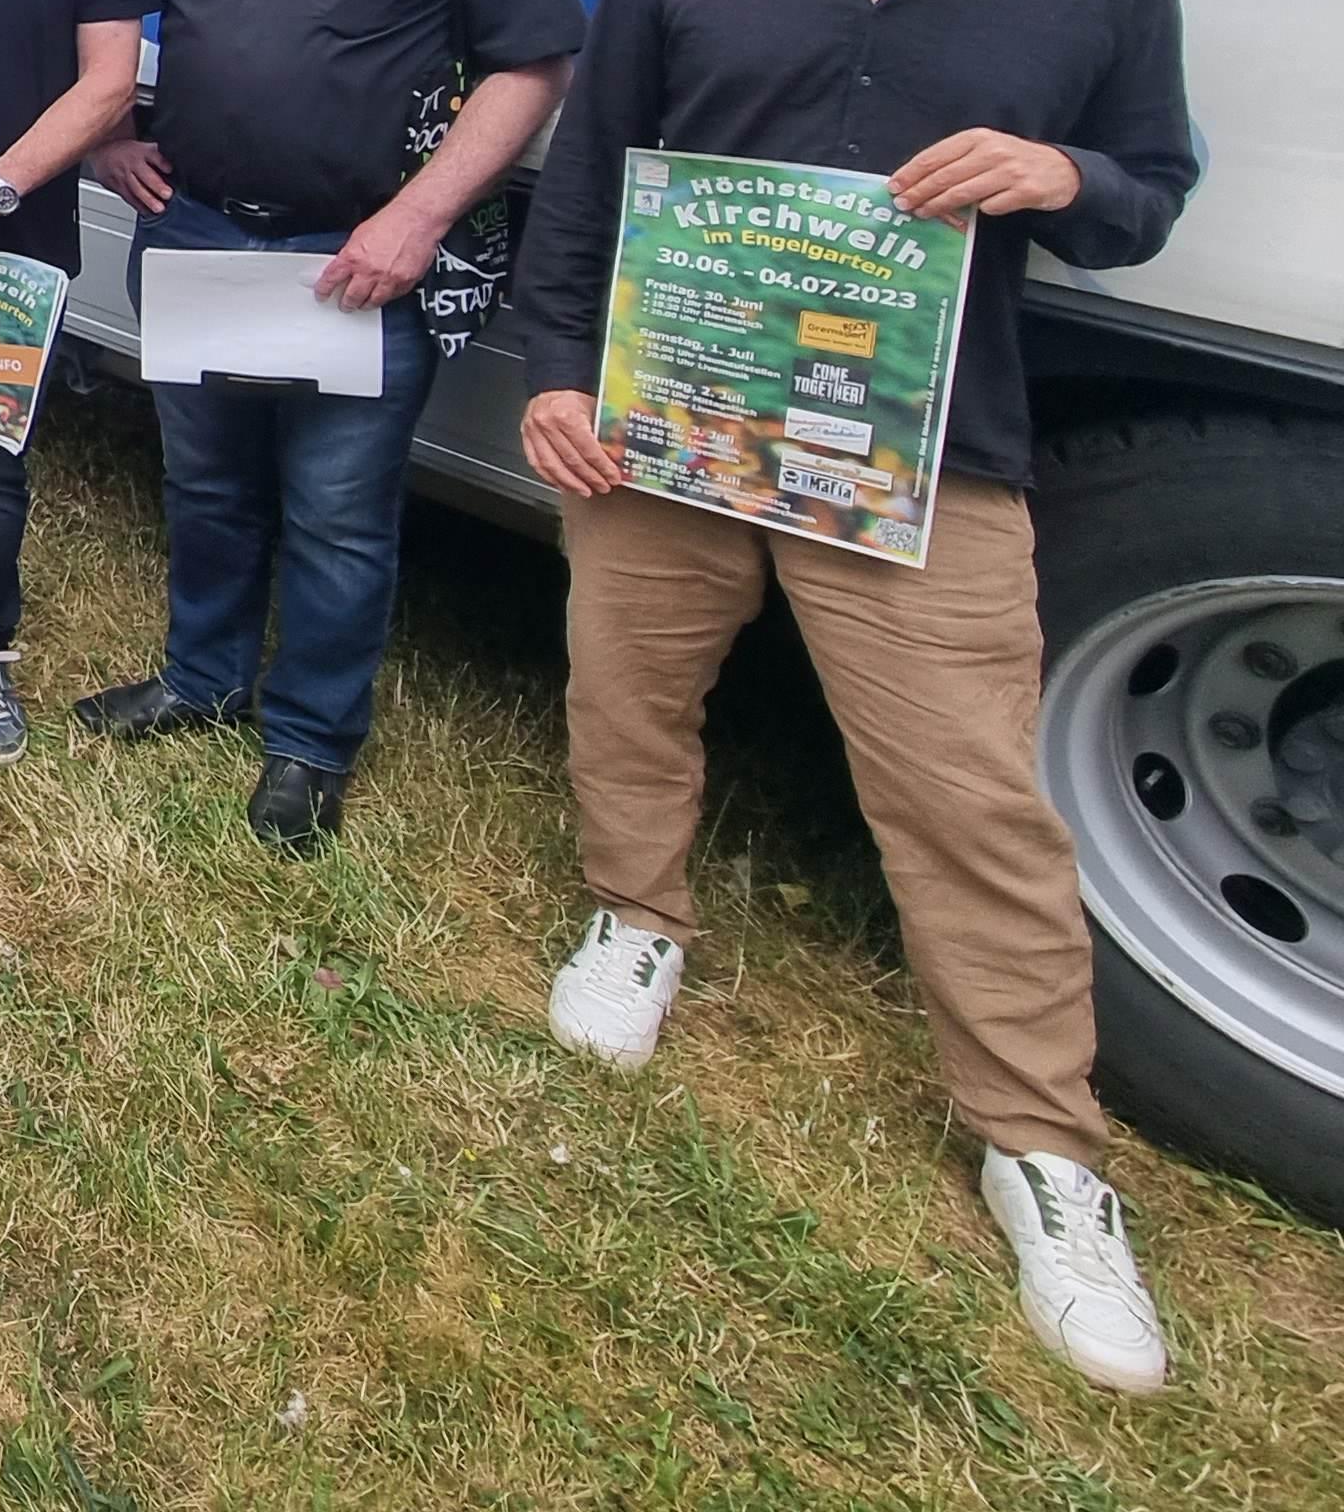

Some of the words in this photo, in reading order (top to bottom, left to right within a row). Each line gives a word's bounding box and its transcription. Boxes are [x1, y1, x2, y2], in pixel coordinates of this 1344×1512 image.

[690, 176, 912, 228] Höchstadter
[673, 200, 928, 270] Kirchweih
[702, 228, 732, 245] im
[741, 228, 893, 281] Engelgarten
[656, 247, 736, 278] 30.06.
[759, 267, 917, 310] 04.07.2023
[794, 375, 866, 406] TOGETHER!
[812, 362, 849, 386] COME
